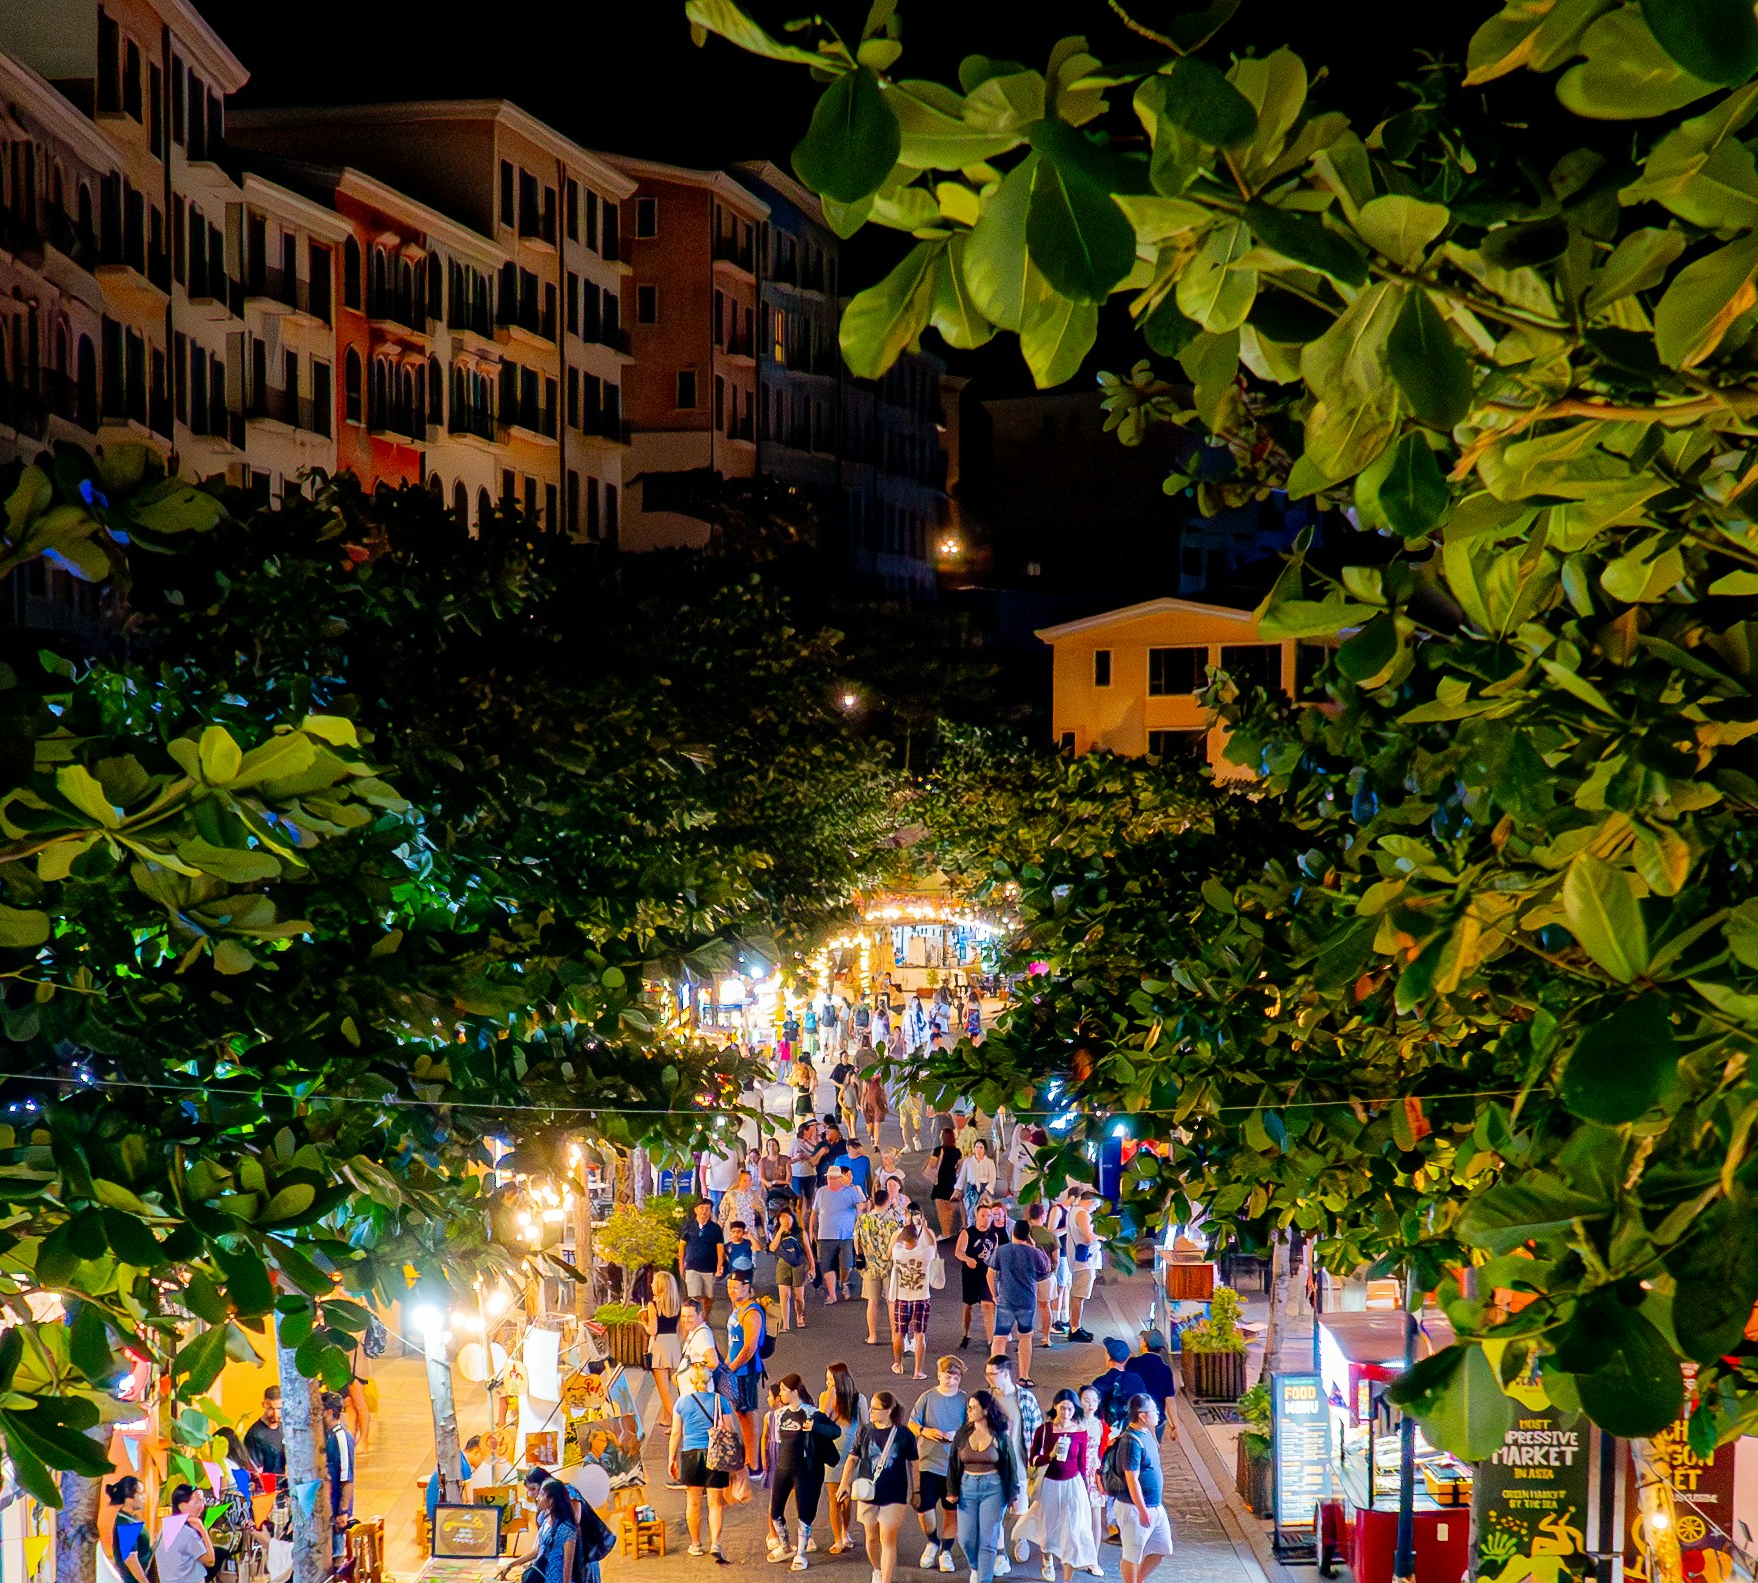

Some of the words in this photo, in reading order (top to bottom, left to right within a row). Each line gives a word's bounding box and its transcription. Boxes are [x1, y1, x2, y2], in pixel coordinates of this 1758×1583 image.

[1284, 1386, 1317, 1400] FOOD
[1505, 1430, 1579, 1446] PRESSIVE
[1491, 1445, 1580, 1467] MARKET
